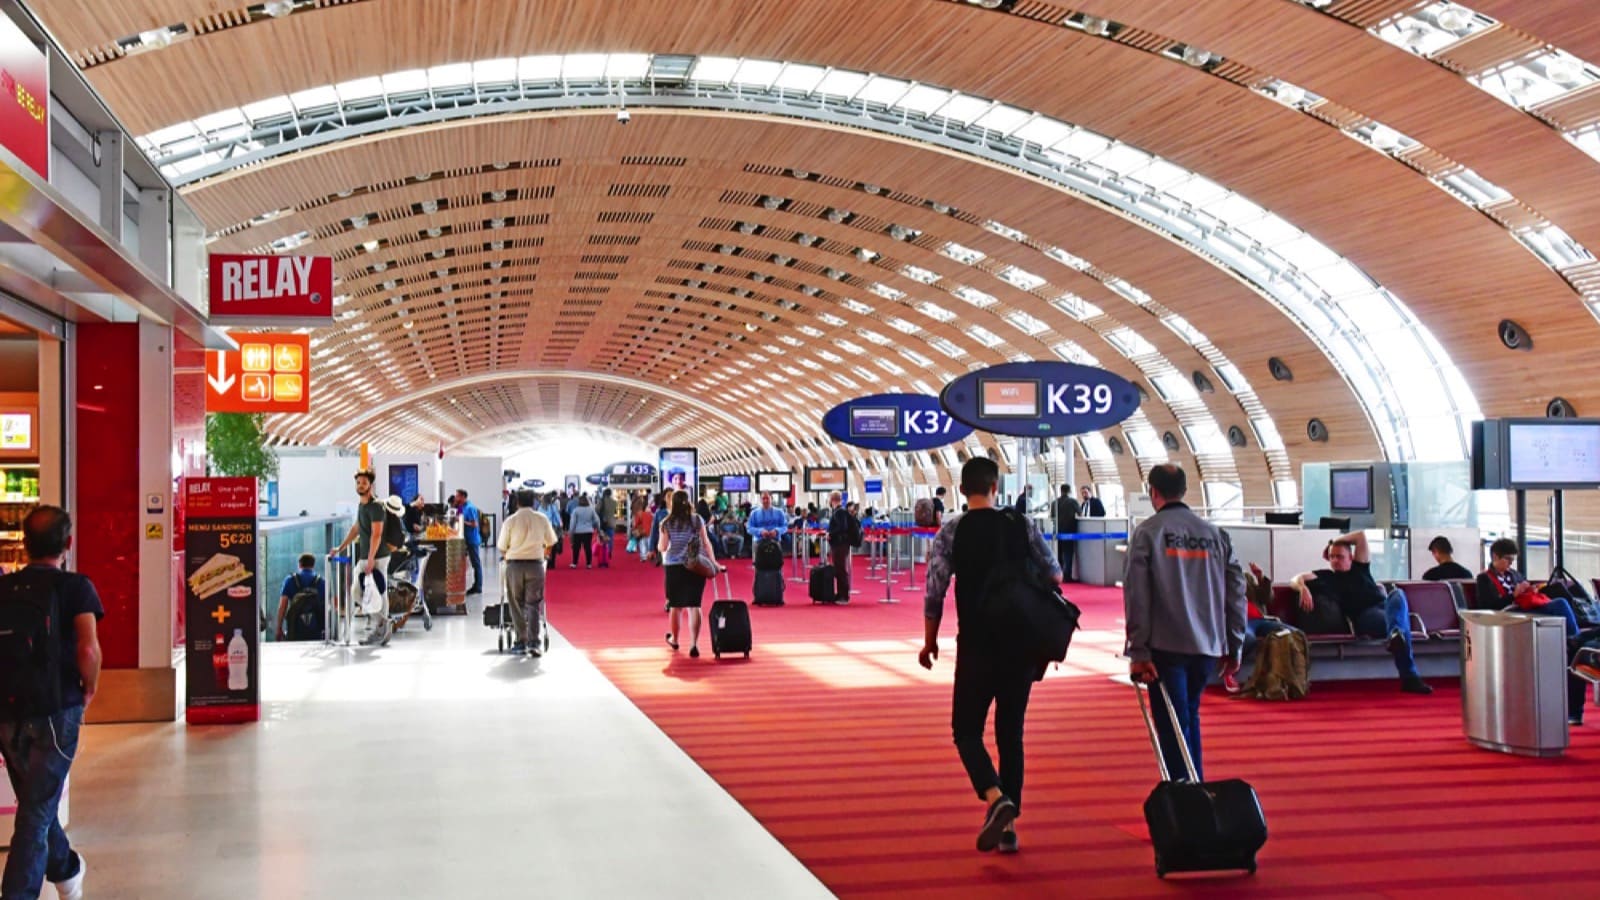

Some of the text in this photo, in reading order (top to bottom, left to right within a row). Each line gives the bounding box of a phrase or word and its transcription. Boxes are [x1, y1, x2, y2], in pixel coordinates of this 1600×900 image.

[222, 256, 314, 302] RELAY
[1047, 383, 1113, 415] K39
[903, 409, 953, 435] K37
[629, 463, 650, 475] K35
[189, 482, 211, 494] RELAY
[1164, 533, 1219, 550] Falcon
